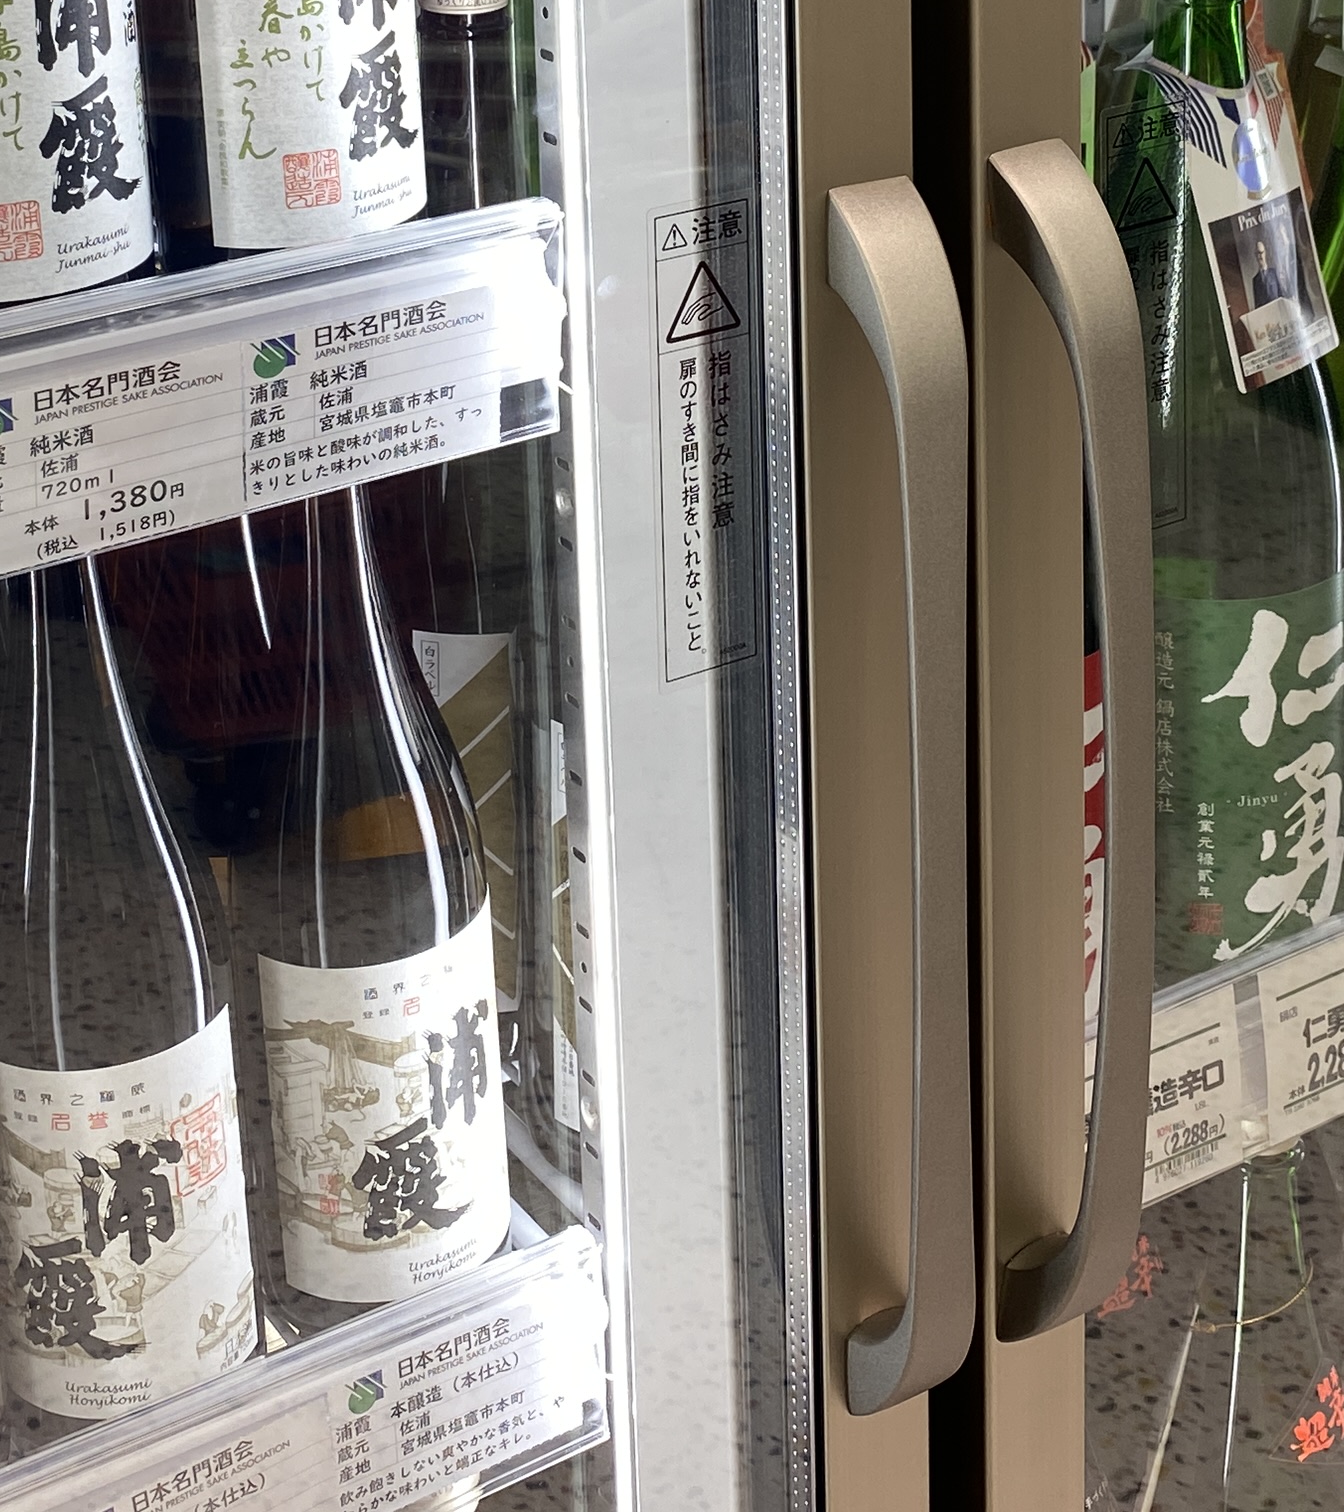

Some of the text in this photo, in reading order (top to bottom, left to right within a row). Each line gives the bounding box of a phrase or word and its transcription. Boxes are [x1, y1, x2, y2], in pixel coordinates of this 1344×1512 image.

[1138, 113, 1179, 142] 注意
[56, 225, 130, 255] Urakasumi
[692, 209, 743, 246] 注意
[56, 240, 131, 274] Junmai-shu
[314, 300, 447, 348] 日本名門酒会
[34, 361, 181, 413] 日本名門酒会
[249, 360, 368, 405] 浦霞 純米酒
[250, 387, 353, 429] 蔵元 佐浦
[250, 385, 456, 451] 産地 宮城県塩竈市本町
[30, 424, 94, 458] 純米酒
[709, 352, 735, 529] 指はさみ注意
[41, 453, 79, 478] 佐浦
[24, 480, 184, 536] 本体 1,380円
[679, 357, 706, 654] 扉のすき間に指をいれないこと。
[37, 509, 175, 560] (税込 1,518円)
[1237, 793, 1278, 807] Jinyu
[1288, 1085, 1305, 1100] 本体
[408, 1239, 477, 1273] Urakasumi
[411, 1251, 476, 1284] Honjikomi
[398, 1318, 509, 1378] 日本名門酒会
[64, 1379, 151, 1396] Urakasumi
[68, 1392, 151, 1409] Honjikomi
[336, 1416, 371, 1444] 浦霞
[337, 1411, 430, 1464] 蔵元 佐浦
[339, 1390, 525, 1484] 産地 宮城県塩竈市本町
[132, 1441, 253, 1512] 日本名門酒会
